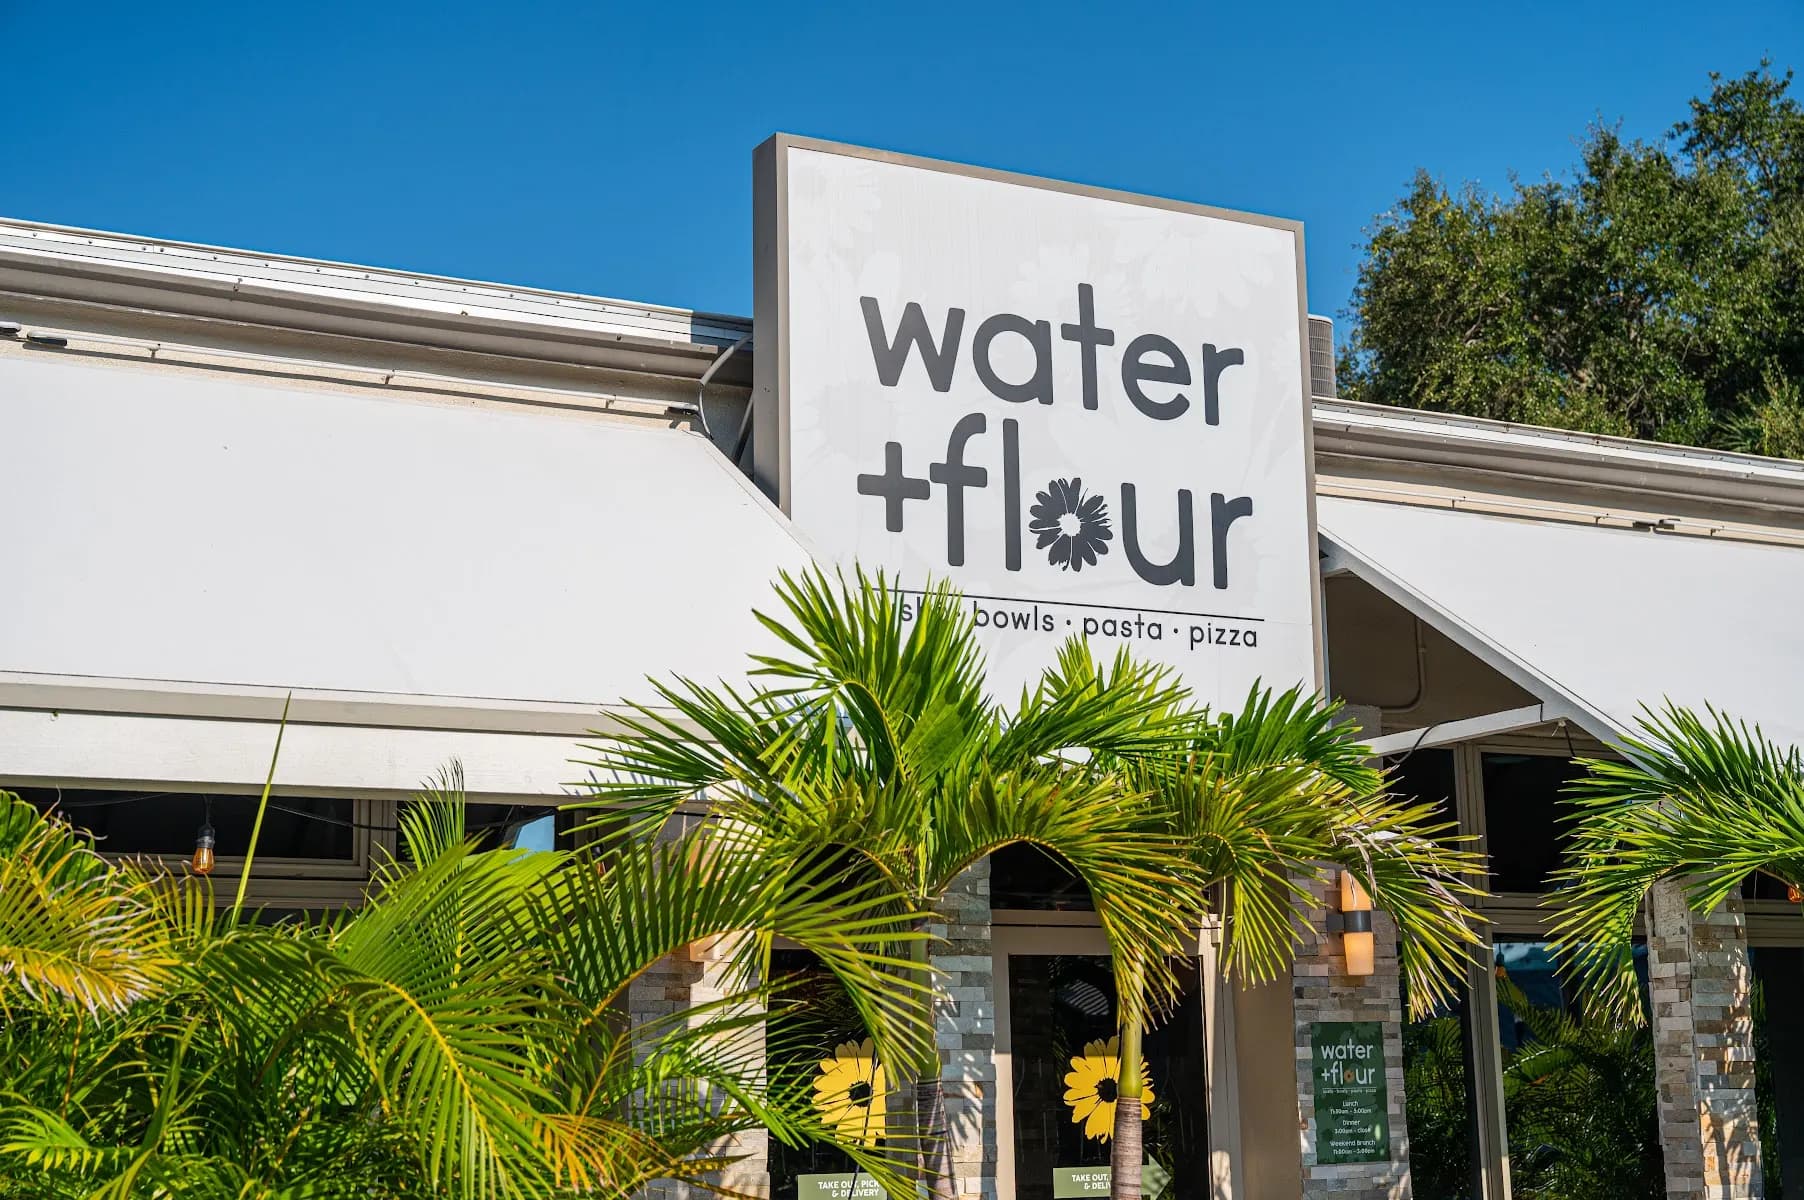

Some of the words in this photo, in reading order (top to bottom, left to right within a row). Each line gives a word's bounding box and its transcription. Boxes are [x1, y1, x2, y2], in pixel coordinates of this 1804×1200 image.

[860, 283, 1244, 425] water
[974, 601, 1055, 632] bowls
[1084, 613, 1162, 639] pasta
[1190, 622, 1258, 651] pizza
[1321, 1038, 1374, 1059] water
[818, 1181, 839, 1189] TAKE
[1072, 1174, 1090, 1182] TAKE
[831, 1190, 839, 1198] &
[841, 1188, 880, 1197] DELIVERY
